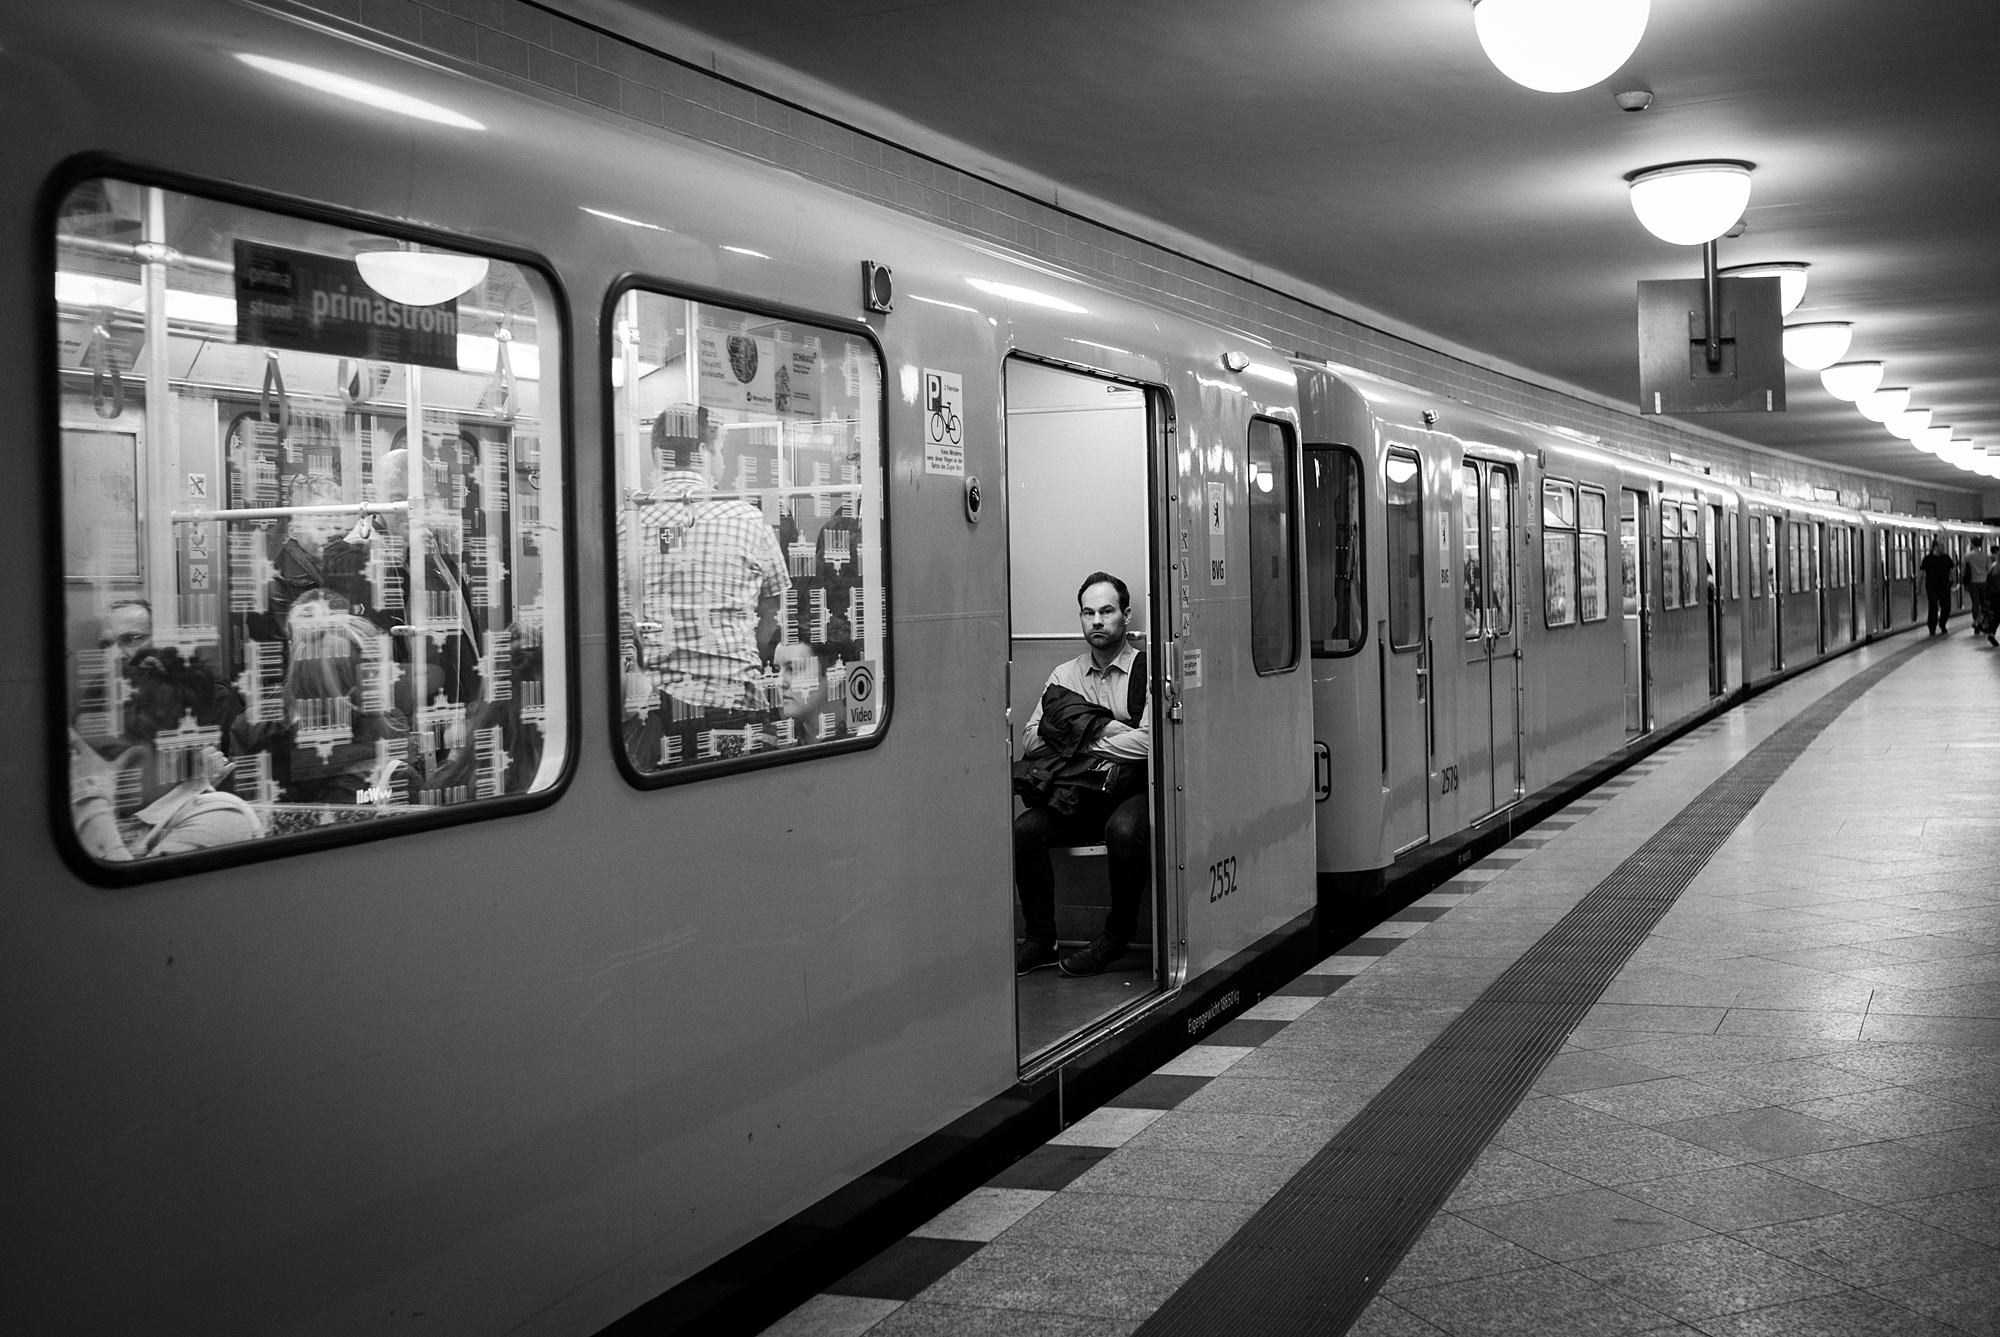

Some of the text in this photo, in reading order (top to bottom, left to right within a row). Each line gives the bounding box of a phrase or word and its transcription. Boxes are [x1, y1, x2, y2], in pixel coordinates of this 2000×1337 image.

[311, 284, 456, 335] primastrom
[928, 374, 940, 410] P
[1212, 560, 1224, 580] BVG
[851, 706, 872, 723] Video
[1441, 764, 1458, 795] 2579
[1209, 855, 1237, 903] 2552
[1188, 1001, 1220, 1034] Eigengewicht
